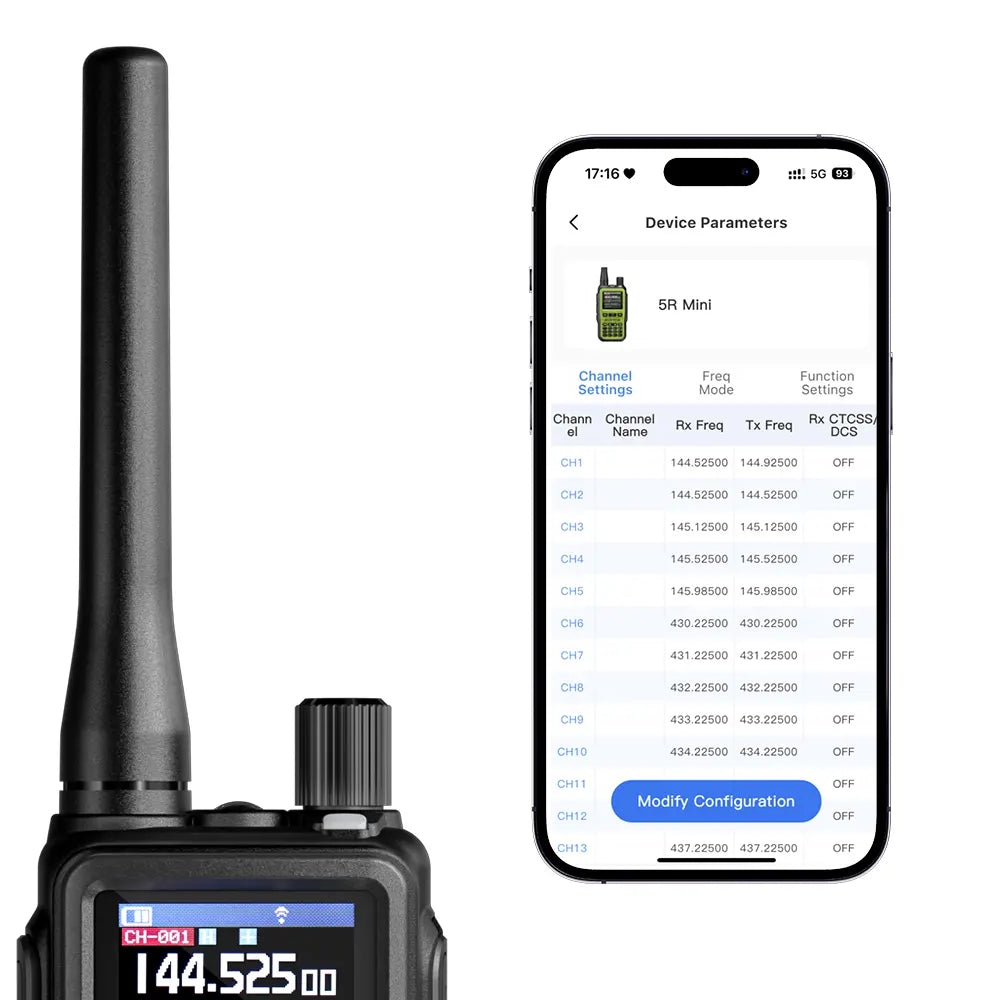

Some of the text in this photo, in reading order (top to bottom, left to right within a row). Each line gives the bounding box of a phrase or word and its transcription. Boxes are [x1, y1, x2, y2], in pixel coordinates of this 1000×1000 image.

[585, 168, 619, 179] 17:16
[811, 169, 826, 179] 5G
[646, 216, 787, 228] Device Parameters
[659, 299, 711, 310] 5R Mini
[579, 371, 631, 381] Channel
[703, 371, 730, 383] Freq
[801, 371, 854, 381] Function
[579, 384, 632, 397] Settings
[700, 384, 733, 395] Mode
[802, 384, 853, 397] Settings
[554, 414, 591, 424] Chann
[606, 414, 654, 424] Channel
[810, 414, 824, 424] Rx
[676, 420, 723, 432] Rx Freq
[746, 420, 792, 432] Tx Freq
[567, 427, 577, 437] el
[613, 427, 647, 436] Name
[831, 427, 857, 436] DCS
[561, 458, 581, 467] CH1
[672, 458, 728, 467] 144.52500
[741, 458, 797, 467] 144.92500
[833, 458, 854, 467] OFF
[561, 490, 583, 499] CH2
[672, 490, 728, 499] 144.52500
[741, 490, 797, 499] 144.52500
[833, 490, 854, 499] OFF
[561, 522, 583, 531] CH3
[672, 522, 728, 531] 145.12500
[741, 522, 797, 531] 145.12500
[833, 522, 854, 531] OFF
[561, 555, 583, 563] CH4
[672, 555, 728, 563] 145.52500
[741, 554, 797, 563] 145.52500
[833, 555, 854, 563] OFF
[561, 587, 583, 595] CH5
[672, 587, 728, 595] 145.98500
[741, 587, 797, 595] 145.98500
[833, 587, 854, 595] OFF
[561, 619, 583, 627] CH6
[671, 619, 728, 627] 430.22500
[740, 619, 797, 627] 430.22500
[833, 619, 854, 627] OFF
[561, 651, 583, 659] CH7
[671, 651, 728, 660] 431.22500
[740, 651, 797, 660] 431.22500
[833, 651, 854, 660] OFF
[561, 683, 583, 692] CH8
[671, 683, 728, 692] 432.22500
[740, 683, 797, 692] 432.22500
[833, 683, 854, 692] OFF
[561, 715, 583, 724] CH9
[671, 715, 728, 724] 433.22500
[740, 715, 797, 724] 433.22500
[833, 715, 854, 724] OFF
[558, 747, 587, 756] CH10
[671, 747, 728, 756] 434.22500
[740, 747, 797, 756] 434.22500
[833, 747, 854, 756] OFF
[557, 780, 585, 788] CH11
[833, 780, 854, 788] OFF
[638, 795, 794, 810] Modify Configuration
[558, 812, 587, 820] CH12
[833, 812, 854, 820] OFF
[557, 843, 587, 854] CH13
[671, 844, 728, 852] 437.22500
[740, 844, 797, 853] 437.22500
[833, 844, 854, 852] OFF
[124, 930, 190, 944] CH-001
